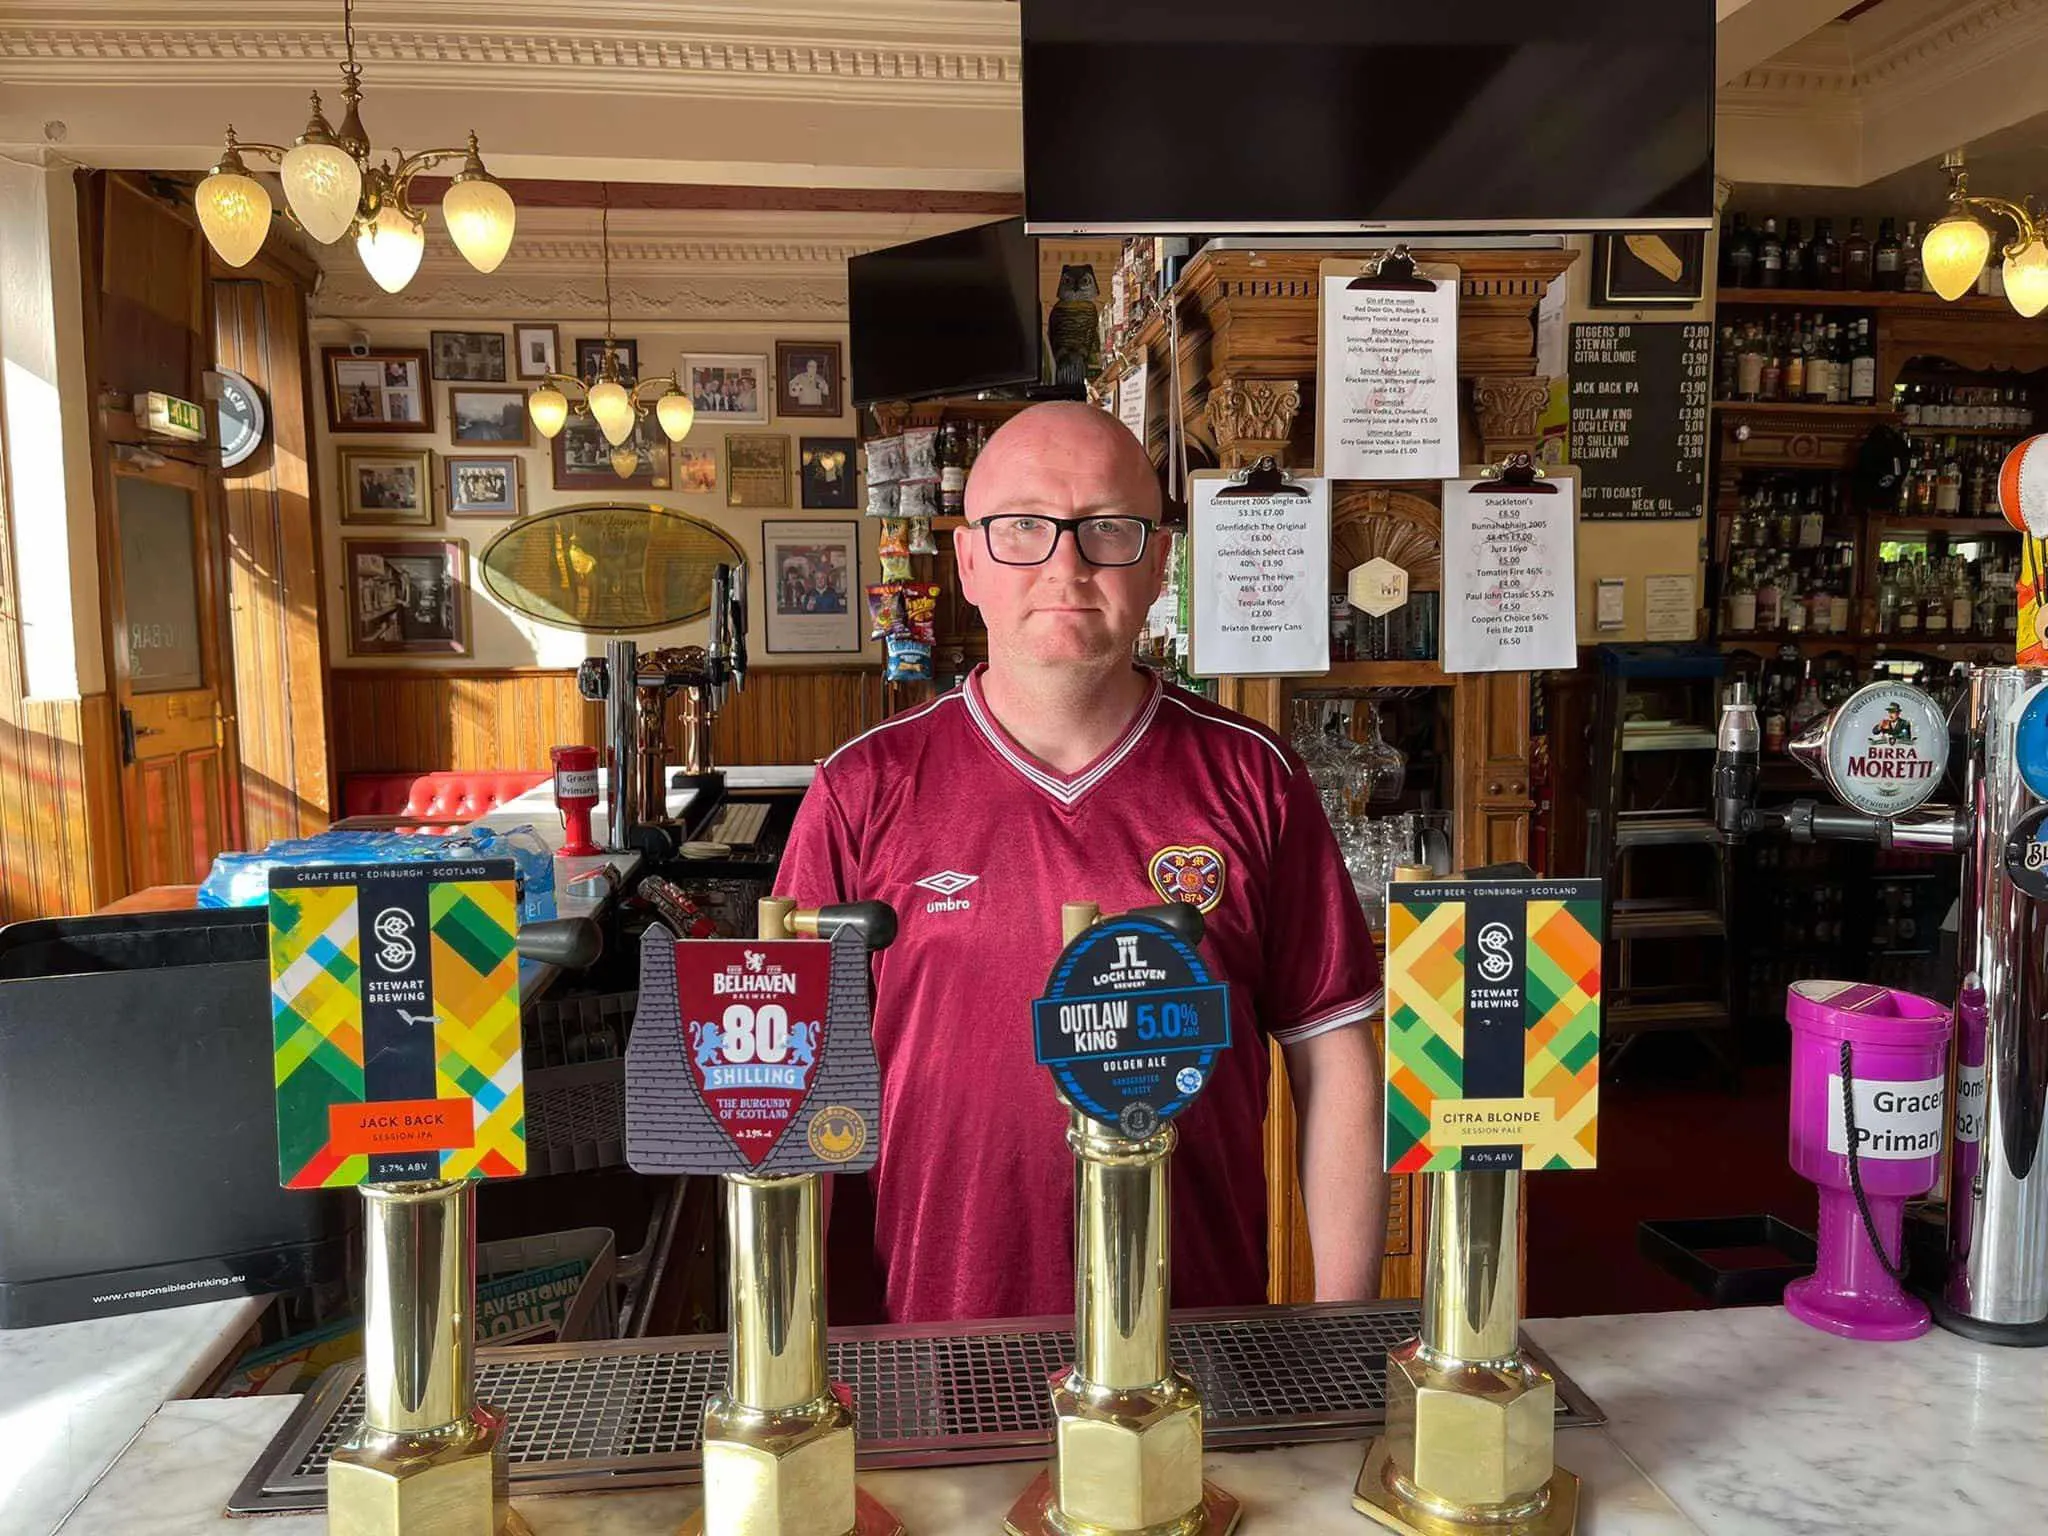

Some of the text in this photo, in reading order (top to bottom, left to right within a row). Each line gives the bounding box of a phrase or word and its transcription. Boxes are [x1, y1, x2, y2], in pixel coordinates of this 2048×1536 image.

[1575, 338, 1618, 350] STEWART
[1575, 351, 1636, 363] CITRA BLONDE
[1573, 382, 1595, 394] JACK
[1599, 382, 1621, 394] BACK
[1573, 408, 1608, 420] OUTLAW
[1613, 408, 1632, 420] KING
[1573, 420, 1627, 432] LOCH LEVEN
[1587, 434, 1629, 447] SHILLING
[1572, 447, 1618, 459] BELHAVEN
[1602, 487, 1612, 499] TO
[1613, 487, 1642, 499] COAST
[1485, 498, 1533, 506] Shackleton's
[1632, 499, 1654, 510] NECK
[1263, 508, 1284, 517] £7.00
[1216, 523, 1307, 532] Glenfiddich The Original
[1251, 534, 1272, 542] £6.00
[1218, 549, 1304, 557] Glenfiddich Select Cask
[1262, 559, 1284, 568] £3.90
[1477, 568, 1508, 577] Tomatin
[1510, 568, 1525, 577] Fire
[1261, 574, 1275, 583] The
[1466, 591, 1482, 600] Paul
[1484, 591, 1502, 600] John
[1503, 591, 1529, 600] Classic
[1238, 599, 1285, 608] Tequila Rose
[1251, 610, 1272, 618] £2.00
[1472, 614, 1502, 624] Coopers
[1504, 614, 1530, 624] Choice
[1221, 624, 1302, 633] Brixton Brewery Cans
[1251, 635, 1272, 643] £2.00
[1868, 747, 1917, 759] BIRRA
[1847, 756, 1933, 778] MORETTI
[297, 867, 486, 881] CRAFT BEER EDINBURGH SCOTLAND
[1414, 889, 1442, 897] CRAFT
[1473, 888, 1523, 896] EDINBURGH
[1531, 887, 1577, 895] SCOTLAND
[1181, 894, 1204, 903] 1874
[927, 898, 970, 913] umbro
[1093, 969, 1166, 986] LOCH LEVEN
[369, 980, 424, 991] STEWART
[713, 973, 796, 994] BELHAVEN
[369, 992, 425, 1003] BREWING
[1470, 989, 1519, 998] STEWART
[1470, 999, 1519, 1009] BREWING
[1060, 1000, 1198, 1041] OUTLAW 5.0%
[722, 1003, 788, 1063] 80
[1075, 1030, 1117, 1052] KING
[1103, 1056, 1167, 1072] GOLDEN ALE
[713, 1068, 795, 1085] SHILLING
[717, 1098, 792, 1109] THE BURGUNDY
[720, 1109, 788, 1119] OF SCOTLAND
[1443, 1112, 1541, 1124] CITRA BLONDE
[360, 1114, 444, 1129] JACK BACK
[373, 1131, 432, 1142] SESSION IPA
[1462, 1127, 1499, 1135] SESSION
[1855, 1128, 1940, 1152] Primary
[1469, 1153, 1513, 1162] 4.0% ABV
[379, 1162, 428, 1174] 3.7% ABV
[92, 1274, 246, 1304] www.responsibledrinking.eu
